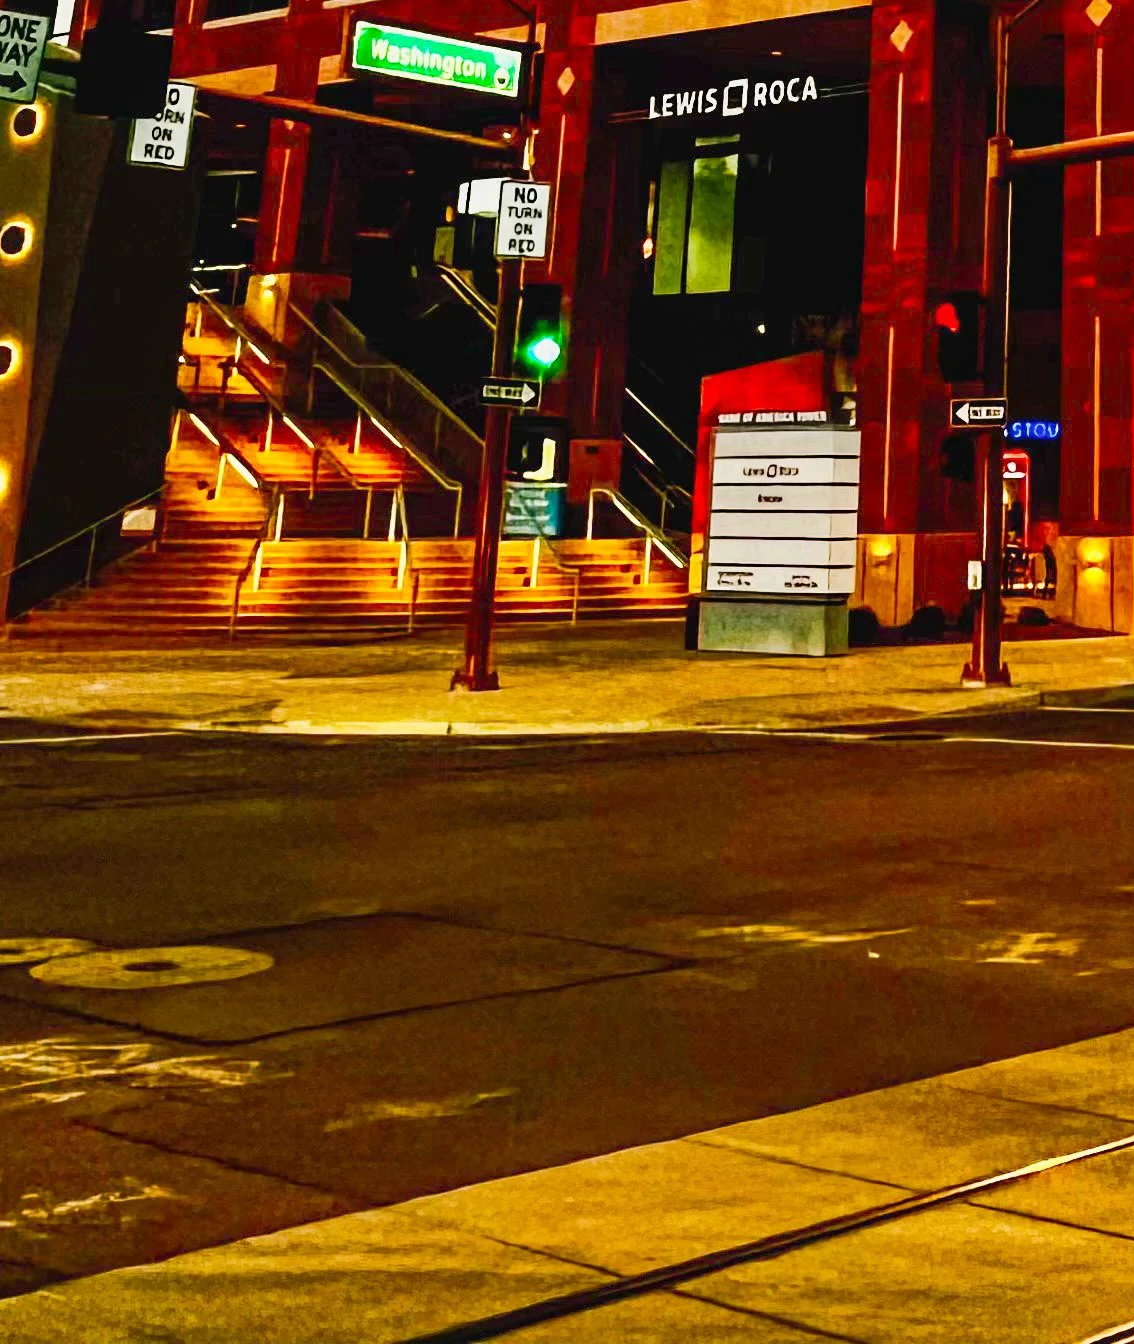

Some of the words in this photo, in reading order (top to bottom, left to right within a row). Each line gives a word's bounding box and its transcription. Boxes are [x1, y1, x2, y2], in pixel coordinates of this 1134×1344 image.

[371, 38, 487, 80] Washington
[649, 87, 718, 119] LEWIS
[753, 75, 818, 107] ROCA
[152, 126, 173, 142] ON
[144, 144, 175, 161] RED
[514, 187, 538, 204] NO
[507, 206, 543, 219] TURN
[514, 222, 533, 235] ON
[508, 238, 536, 254] RED
